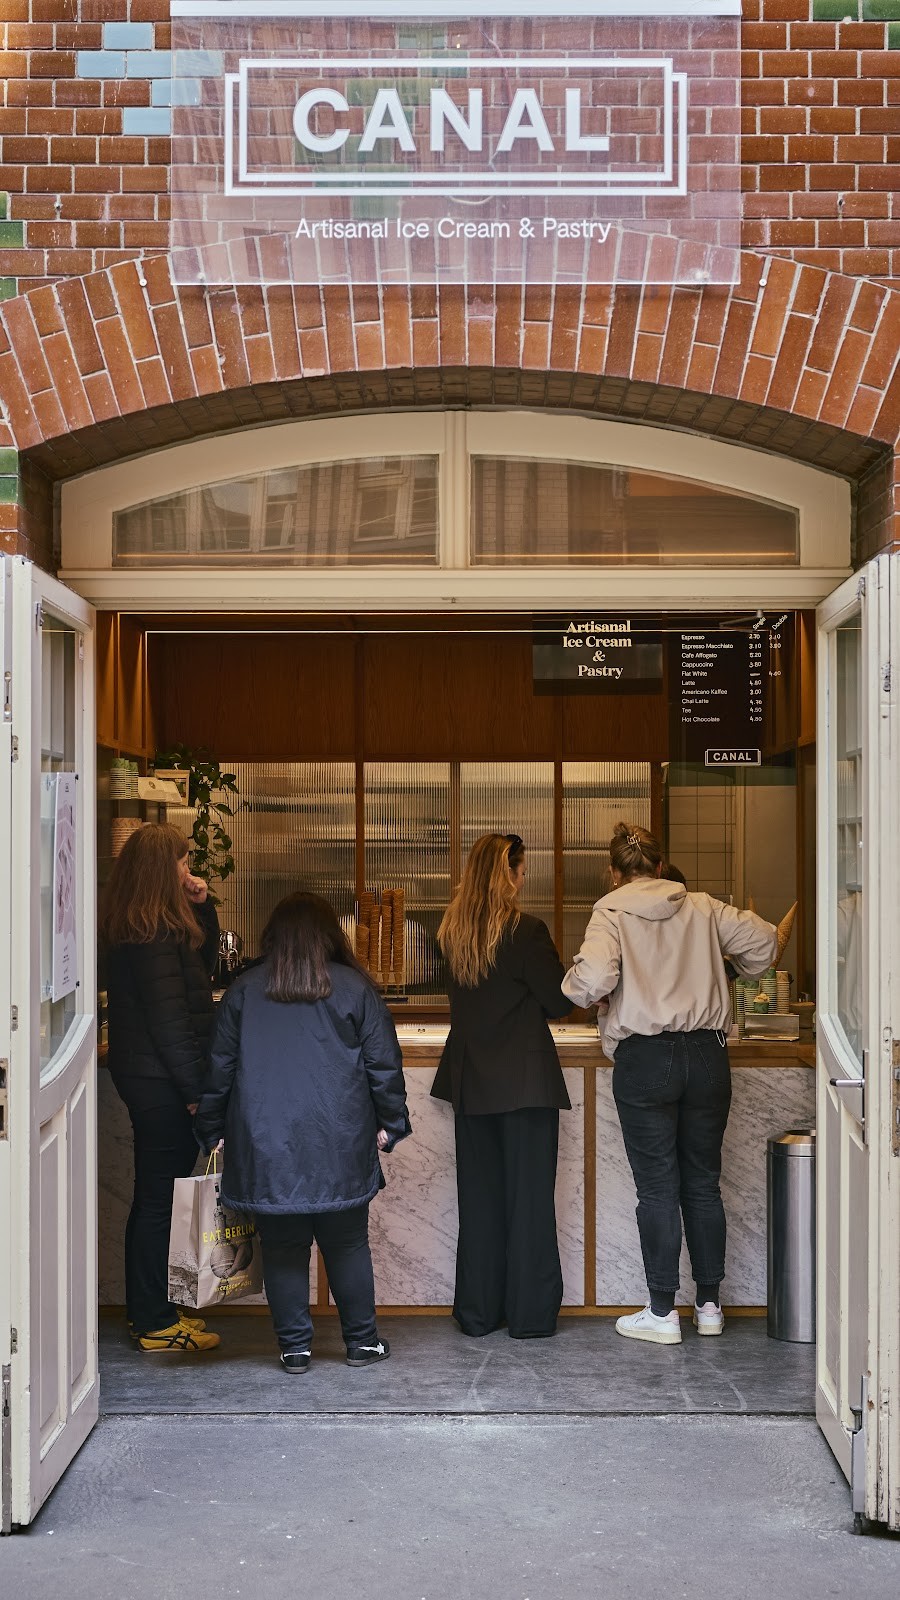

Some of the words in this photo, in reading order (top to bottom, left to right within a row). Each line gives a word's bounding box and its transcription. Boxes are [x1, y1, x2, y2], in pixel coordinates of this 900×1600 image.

[293, 87, 611, 153] CANAL
[295, 217, 388, 239] Artisanal
[396, 217, 430, 239] Ice
[437, 217, 510, 239] Cream
[518, 218, 534, 239] &
[542, 217, 611, 244] Pastry
[566, 620, 631, 633] Artisanal
[772, 614, 788, 630] Double
[563, 635, 583, 648] Ice
[585, 635, 632, 648] Cream
[592, 650, 606, 662] &
[681, 661, 714, 669] Cappuccino
[578, 665, 624, 679] Pastry
[712, 752, 752, 761] CANAL
[203, 1229, 221, 1243] EAT
[225, 1224, 254, 1239] BERLIN
